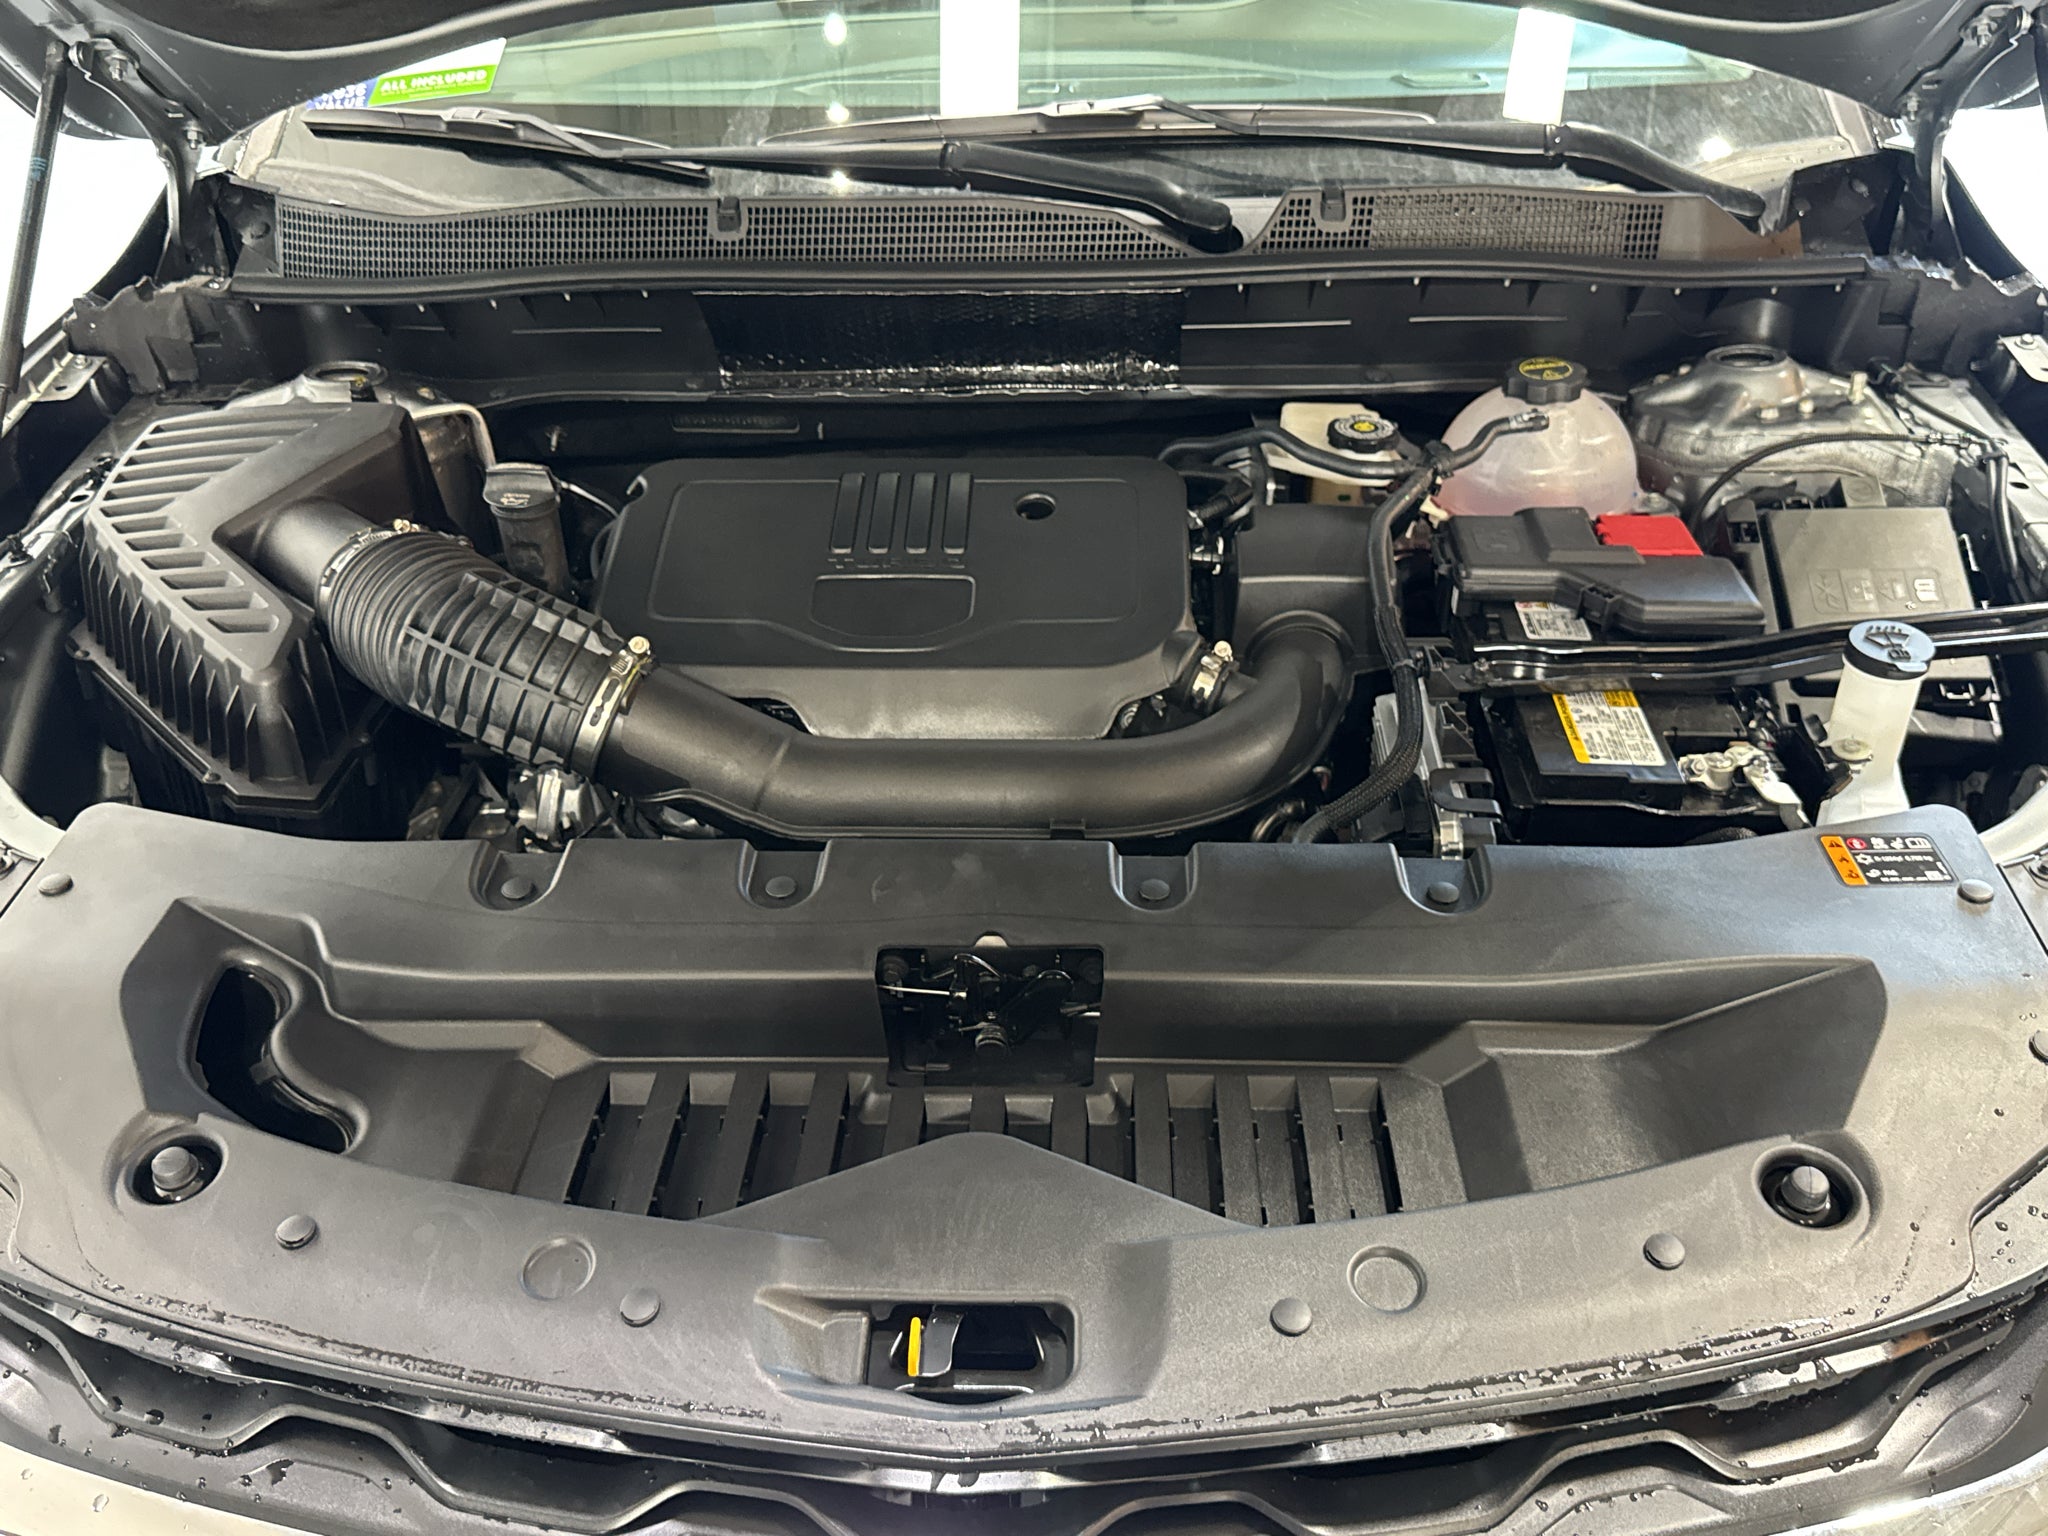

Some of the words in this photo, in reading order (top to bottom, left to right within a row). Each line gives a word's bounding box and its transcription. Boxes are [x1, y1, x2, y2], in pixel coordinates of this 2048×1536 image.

[380, 79, 407, 92] ALL
[411, 69, 487, 88] INCLUDED
[315, 96, 366, 110] VALUE
